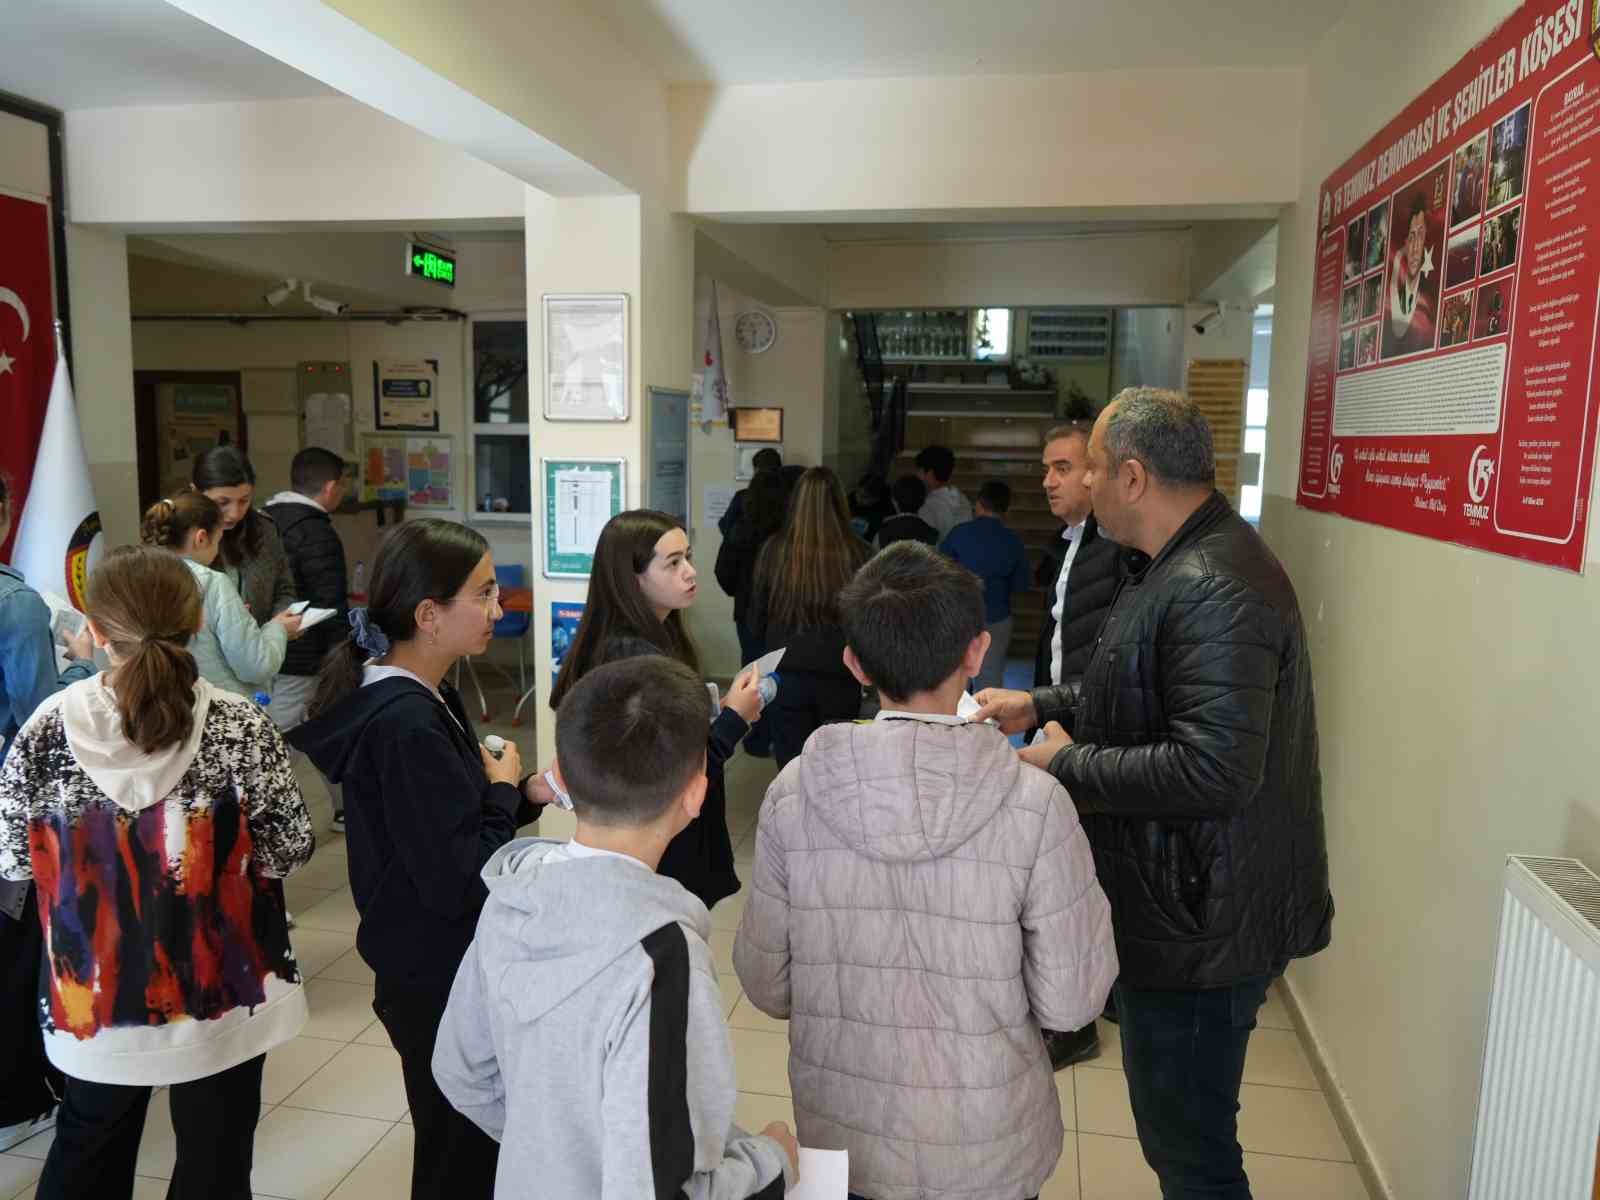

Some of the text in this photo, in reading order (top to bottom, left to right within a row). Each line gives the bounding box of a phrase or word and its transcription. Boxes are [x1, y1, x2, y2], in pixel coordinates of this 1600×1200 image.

[1334, 188, 1342, 216] 15
[1343, 160, 1376, 208] TEMMUZ
[1376, 104, 1435, 186] DEMOKRASİ
[1437, 99, 1451, 143] VE
[1453, 48, 1516, 136] ŞEHİTLER
[1463, 503, 1490, 520] TEMMUZ
